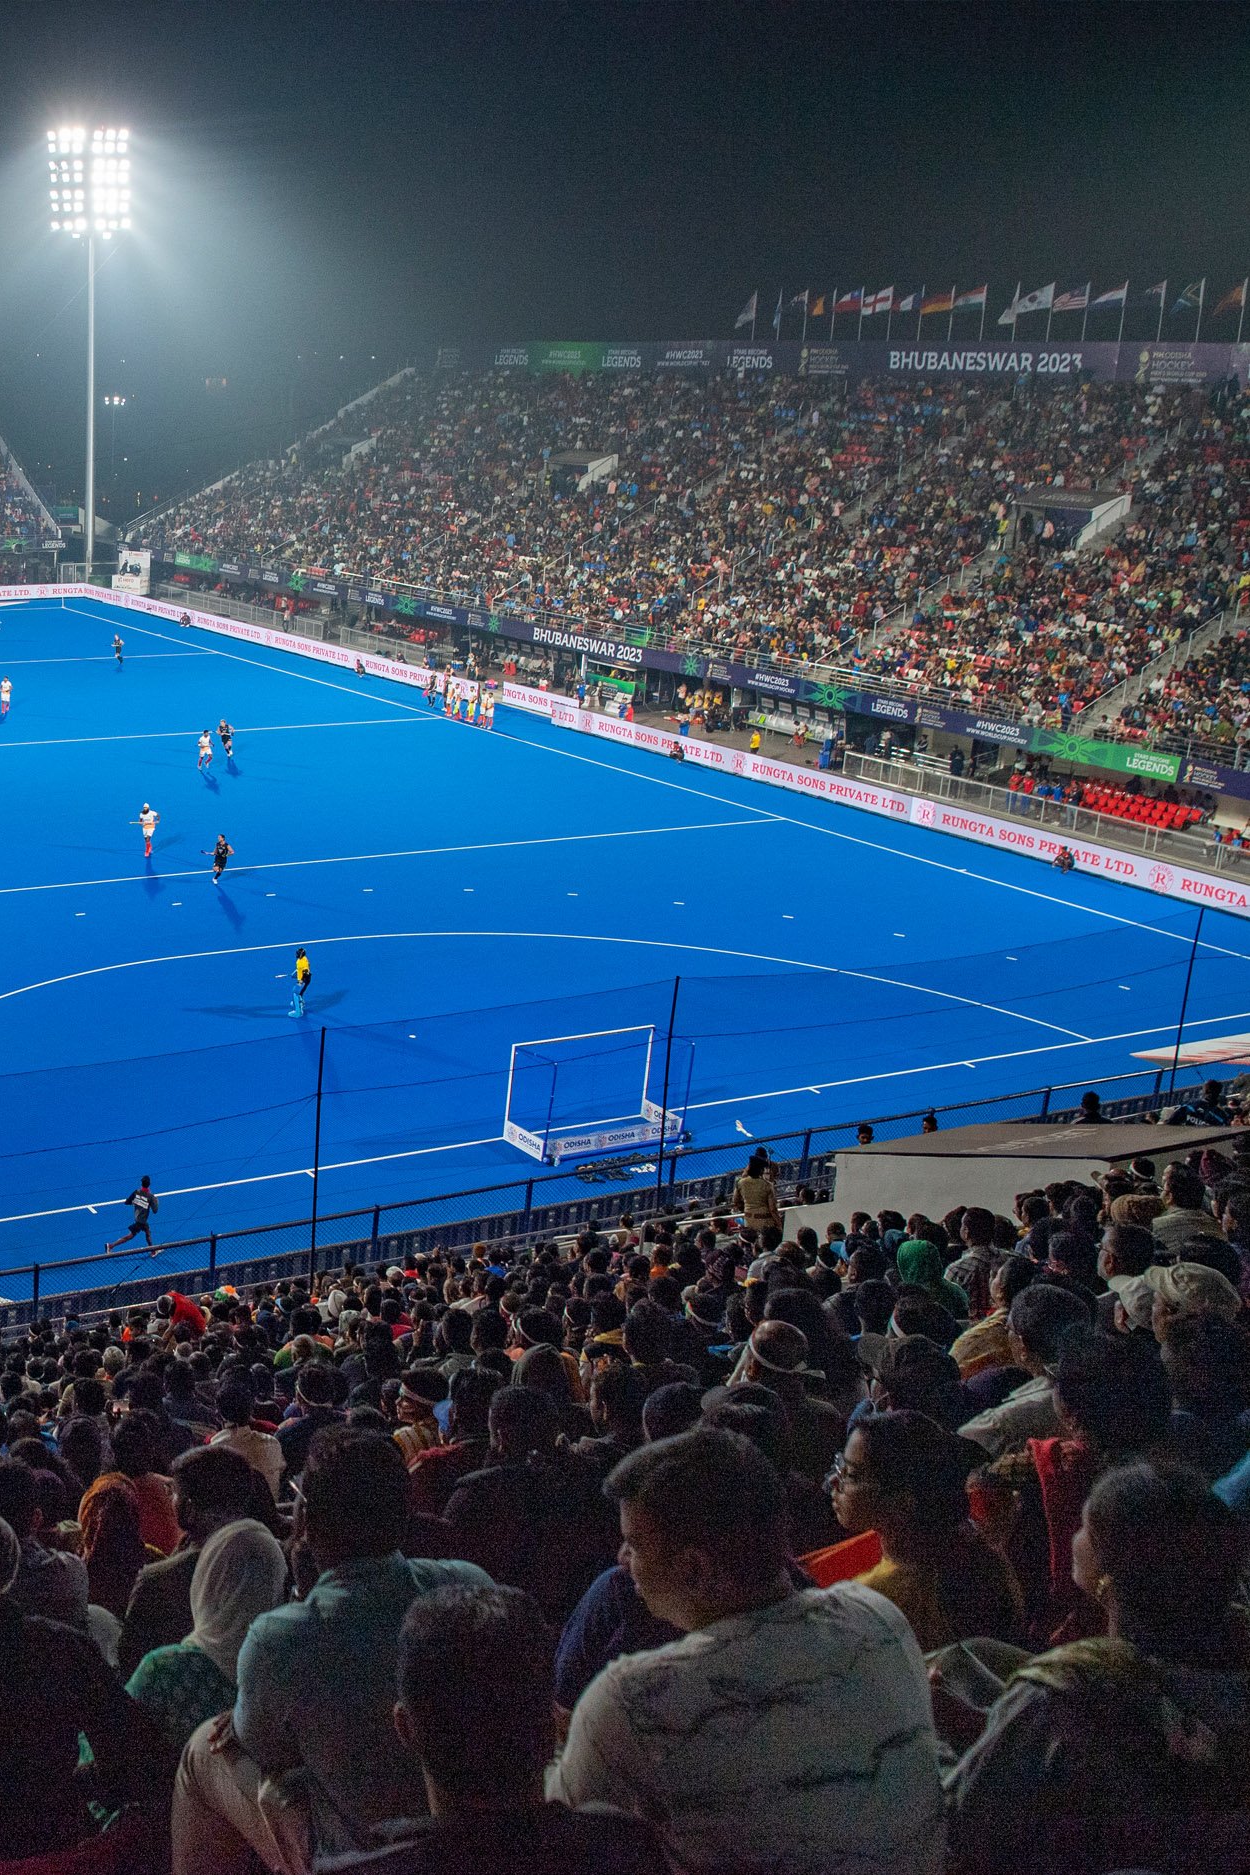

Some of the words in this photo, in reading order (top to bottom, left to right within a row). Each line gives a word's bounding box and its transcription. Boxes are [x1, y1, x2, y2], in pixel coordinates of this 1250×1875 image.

[495, 355, 528, 365] LEGENDS
[550, 351, 581, 359] #HWC2023
[666, 350, 703, 359] #HWC2023
[602, 356, 641, 368] LEGENDS
[727, 356, 772, 368] LEGENDS
[890, 351, 1032, 372] BHUBANESWAR
[1037, 353, 1082, 373] 2023
[1151, 360, 1194, 369] HOCKEY
[263, 573, 278, 583] LEGENDS
[94, 590, 112, 600] PRIVATE
[365, 595, 384, 605] LEGENDS
[131, 598, 146, 610] RUNGTA
[147, 603, 157, 613] SONS
[158, 605, 176, 616] PRIVATE
[431, 606, 452, 615] #HWC2023
[197, 616, 215, 627] RUNGTA
[216, 621, 228, 631] SONS
[229, 624, 249, 636] PRIVATE
[250, 630, 261, 639] LTD.
[274, 637, 296, 648] RUNGTA
[297, 642, 311, 653] SONS
[313, 646, 335, 660] PRIVATE
[337, 652, 350, 663] LTD.
[533, 627, 615, 657] BHUBANESWAR
[617, 644, 643, 663] 2023
[365, 660, 390, 673] RUNGTA
[391, 667, 408, 678] SONS
[755, 673, 789, 686] #HWC2023
[528, 695, 547, 705] SONS
[871, 703, 908, 718] LEGENDS
[559, 710, 577, 724] LTD.
[976, 720, 1020, 736] #HWC2023
[598, 722, 633, 738] RUNGTA
[635, 732, 659, 744] SONS
[661, 738, 701, 757] PRATE
[704, 751, 725, 763] LTD.
[1126, 757, 1174, 776] LEGENDS
[1194, 771, 1218, 780] HOCKEY
[752, 763, 794, 782] RUNGTA
[797, 775, 826, 791] SONS
[829, 784, 878, 806] PRIVATE
[882, 799, 908, 814] LTD.
[942, 813, 994, 837] RUNGTA
[999, 829, 1035, 848] SONS
[1038, 840, 1100, 866] PRIATE
[1104, 858, 1137, 877] LTD.
[1181, 878, 1247, 907] RUNGTA
[1187, 1114, 1209, 1125] POLIC
[651, 1124, 677, 1134] ODSHA
[518, 1133, 541, 1151] ODISHA
[608, 1132, 635, 1142] ODISHA
[563, 1140, 592, 1149] ODISHA
